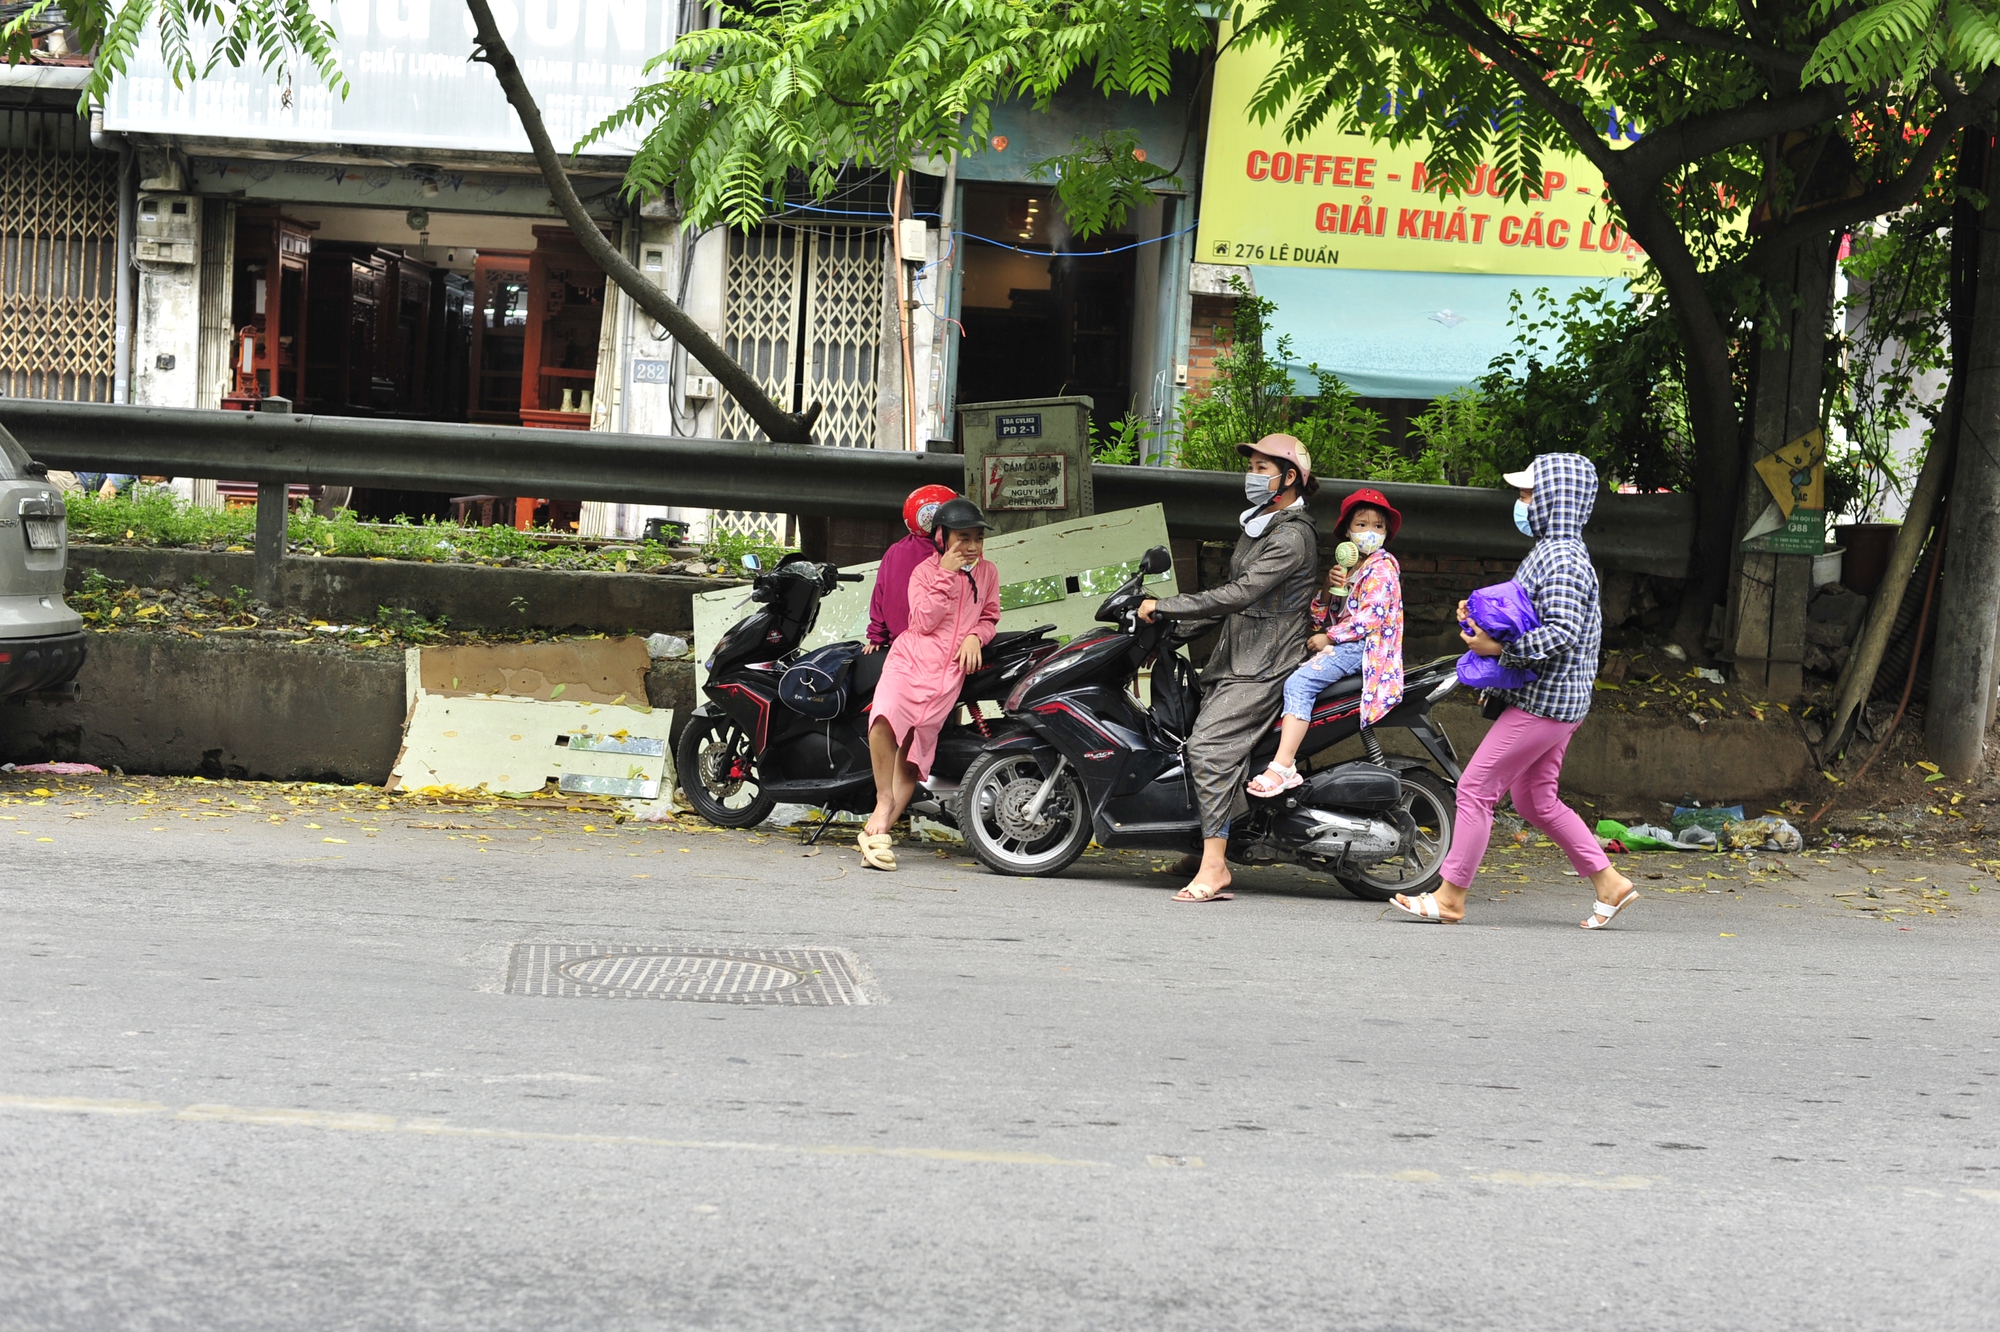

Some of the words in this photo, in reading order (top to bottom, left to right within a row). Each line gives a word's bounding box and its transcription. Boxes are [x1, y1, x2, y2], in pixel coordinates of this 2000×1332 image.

[1246, 150, 1377, 189] COFFEE
[1315, 195, 1388, 237] GIẢI
[1397, 206, 1490, 243] KHÁT
[1499, 211, 1571, 249] CÁC
[1579, 221, 1645, 261] LOẠ
[1235, 243, 1264, 259] 276
[1270, 243, 1289, 261] LÊ
[1293, 244, 1339, 264] DUẨN
[636, 363, 666, 380] 282
[1003, 426, 1017, 435] PD
[1019, 425, 1036, 434] 2-1
